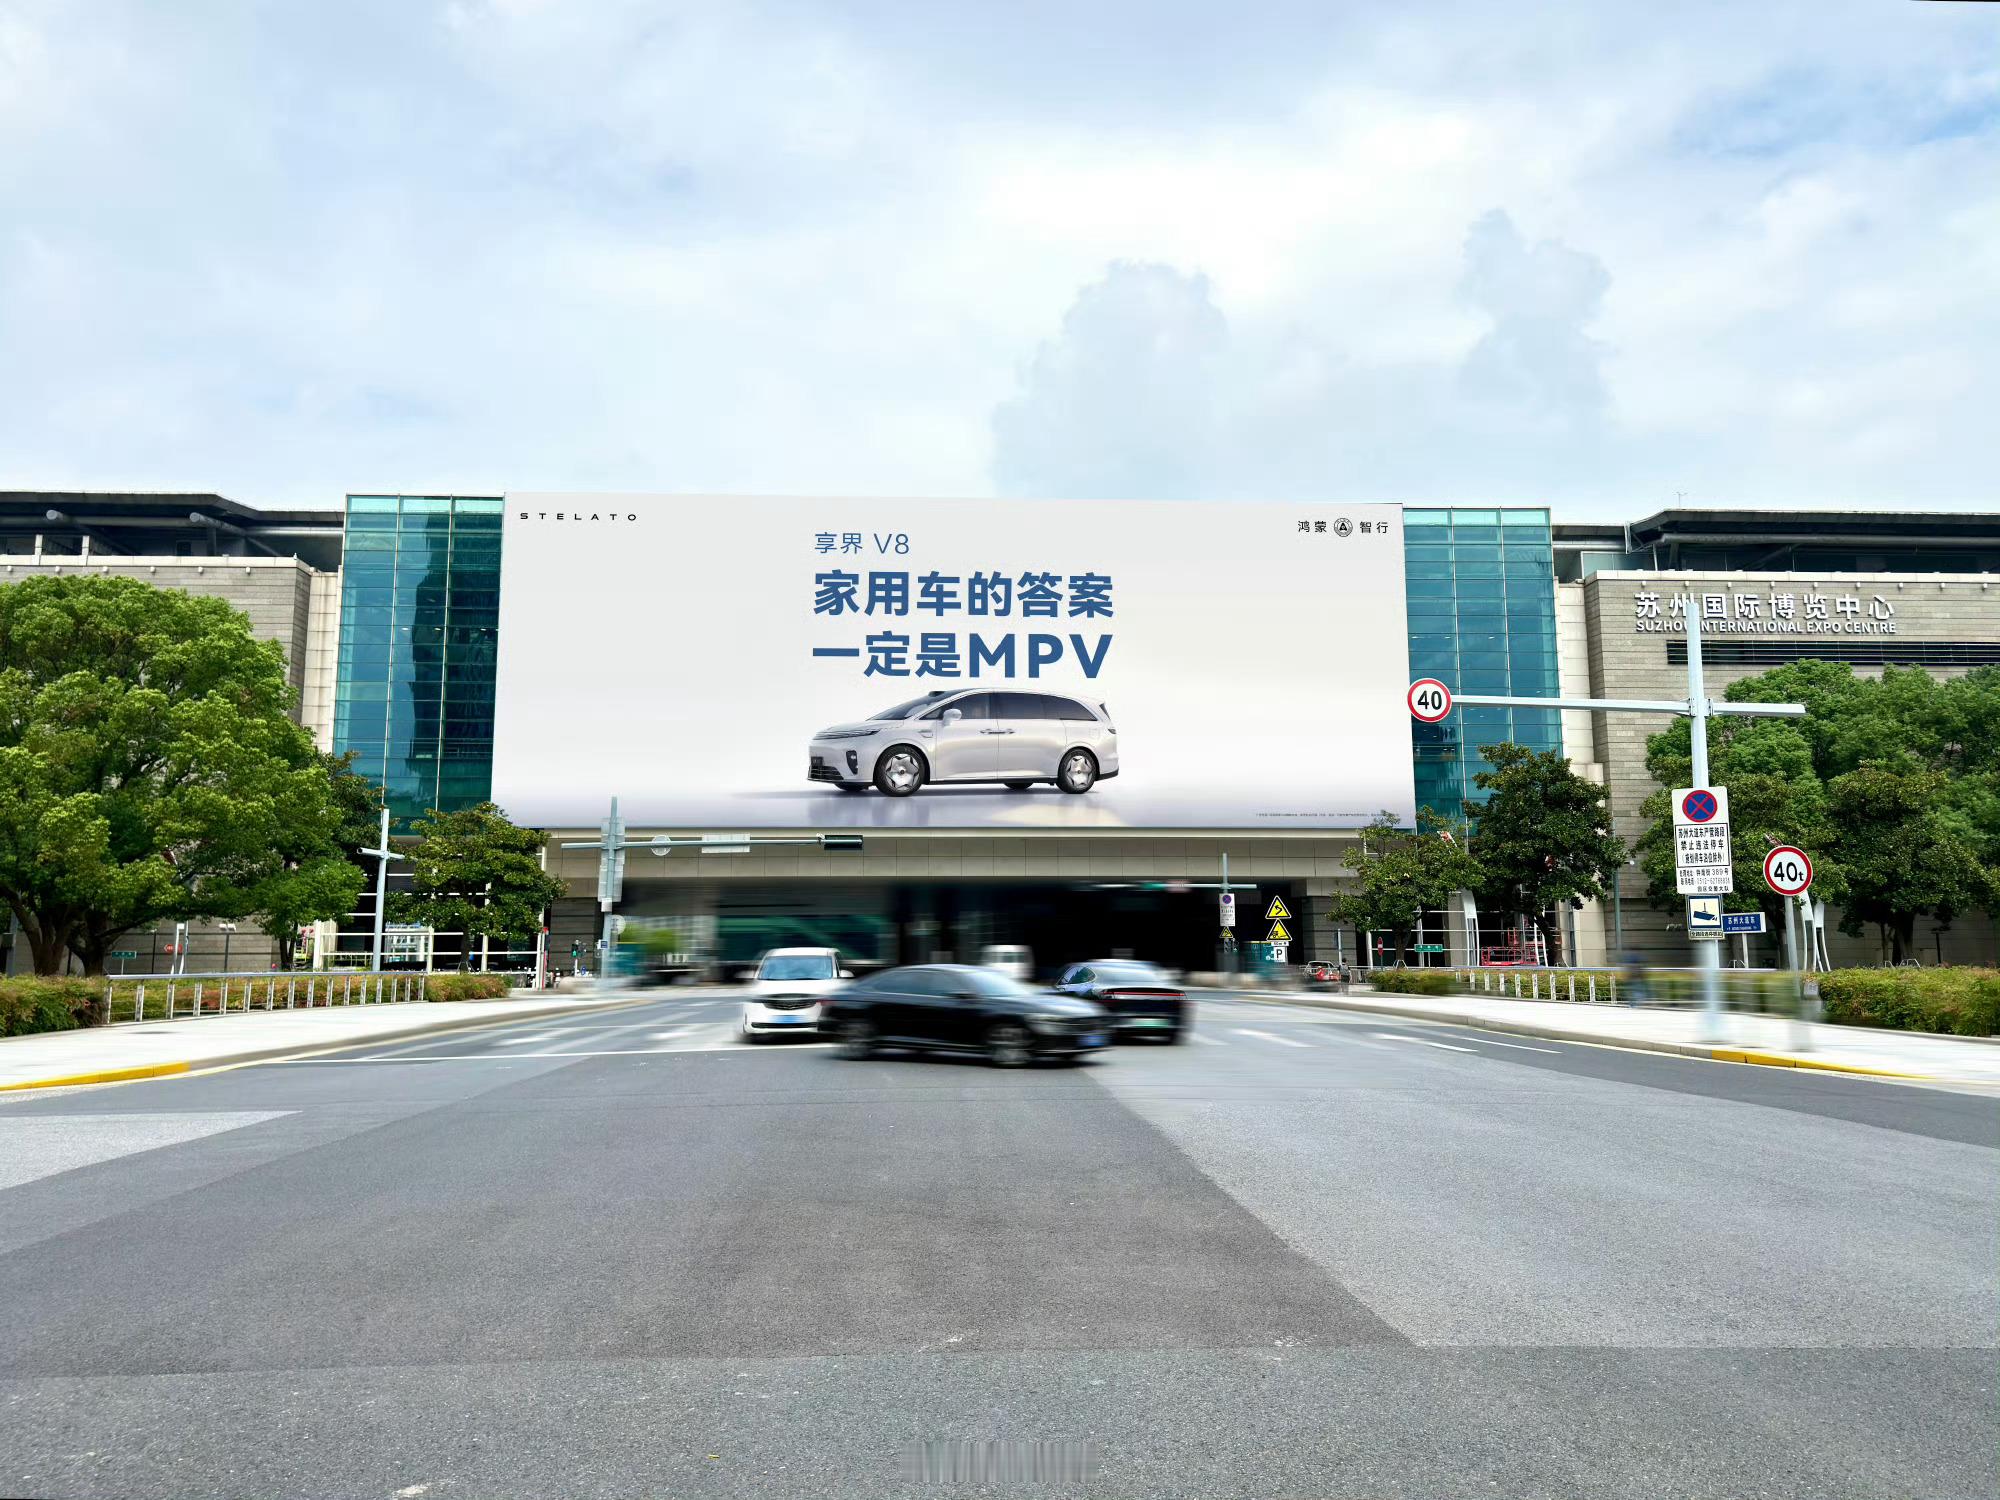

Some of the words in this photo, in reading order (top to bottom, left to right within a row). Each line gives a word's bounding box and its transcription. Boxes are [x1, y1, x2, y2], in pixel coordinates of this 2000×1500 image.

[520, 512, 637, 522] STELATO
[1298, 520, 1327, 533] 鸿蒙
[1360, 521, 1389, 534] 智行
[814, 531, 863, 554] 享界
[873, 533, 910, 555] V8
[813, 569, 1114, 618] 家用车的答案
[1634, 592, 1895, 620] 苏州国际博览中心
[1636, 620, 1689, 632] SUZHO
[1700, 621, 1803, 633] NTERNATIONAL
[1807, 621, 1842, 633] EXPO
[1844, 621, 1897, 634] CENTRE
[812, 630, 1114, 679] 一定是MPV
[1417, 690, 1442, 710] 40
[1276, 948, 1283, 959] P
